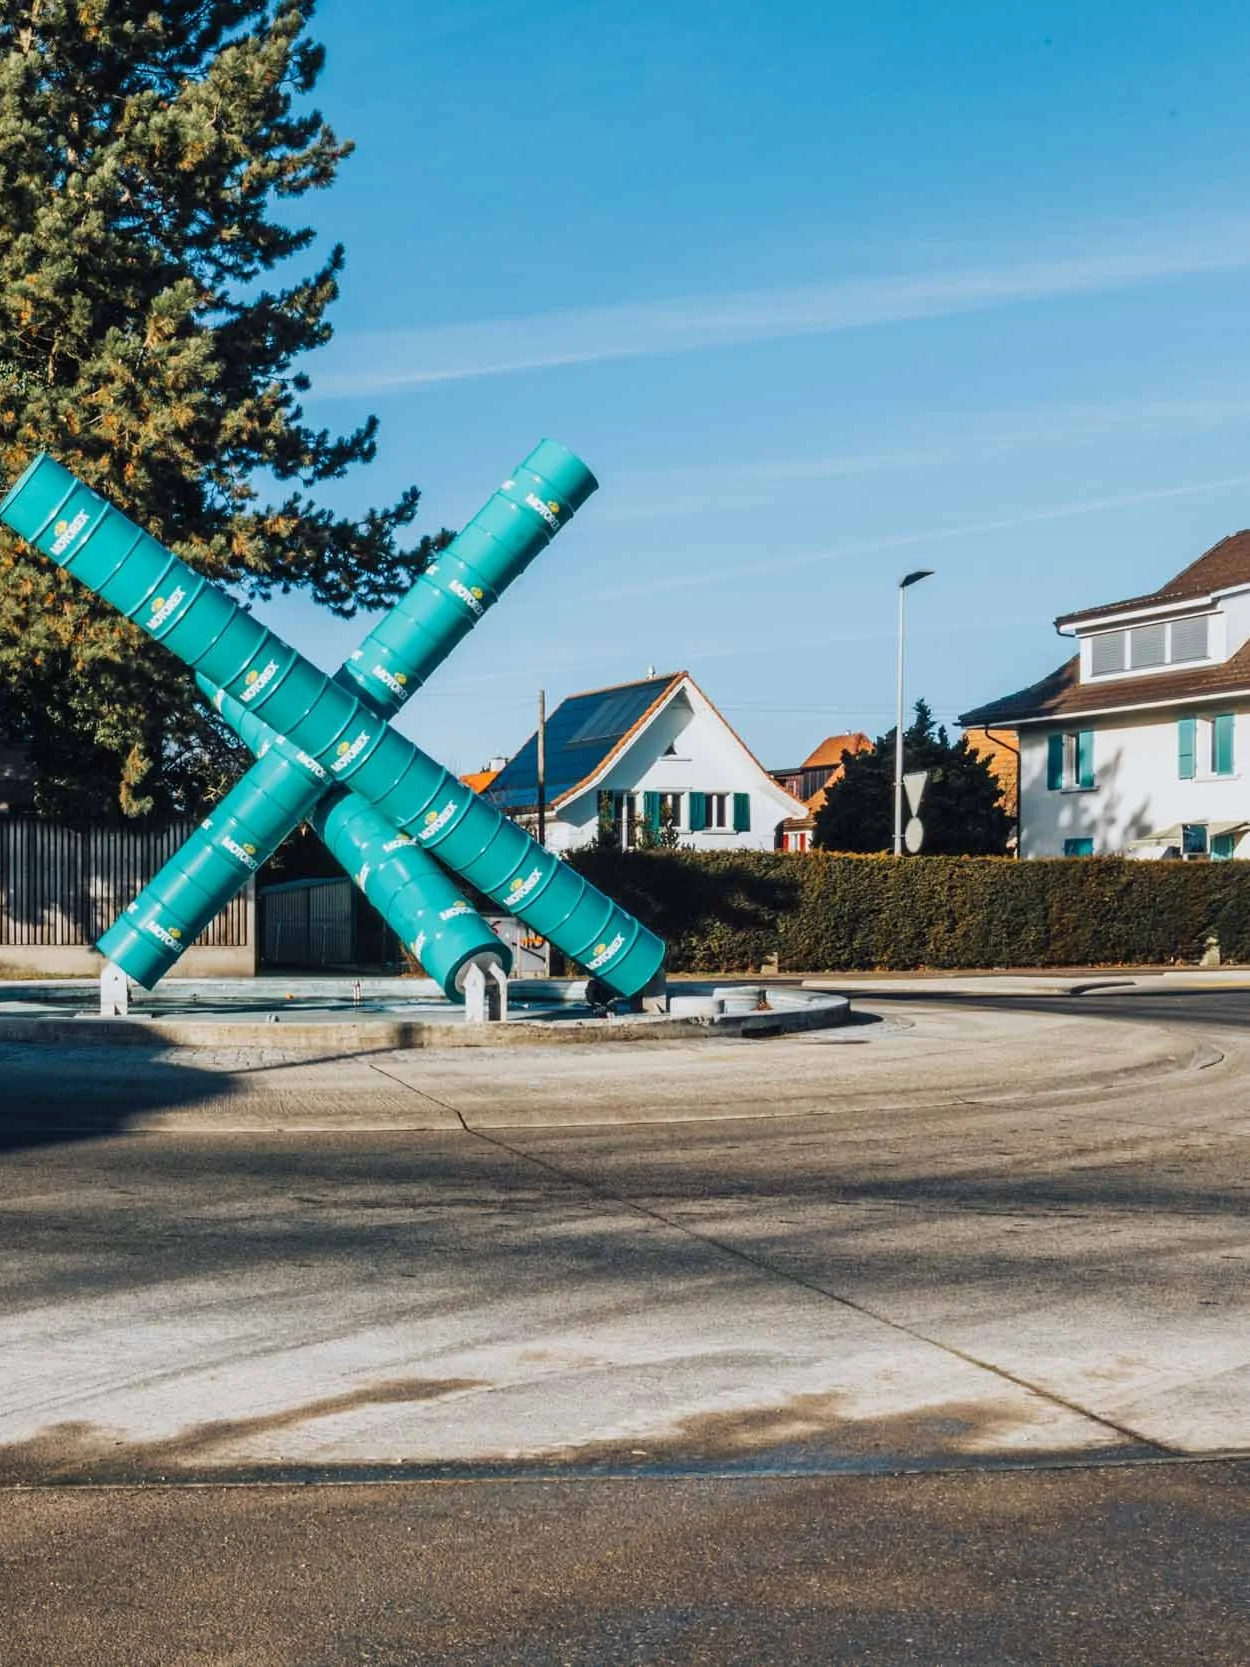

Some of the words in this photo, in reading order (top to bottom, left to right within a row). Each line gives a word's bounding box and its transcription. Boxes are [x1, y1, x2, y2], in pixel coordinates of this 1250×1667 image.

[146, 585, 186, 630] MOTOREX
[239, 659, 278, 702] MOTOREX
[330, 729, 370, 772] MOTOREX
[418, 800, 457, 840] MOTOREX
[503, 867, 542, 905] MOTOREX
[585, 931, 625, 969] MOTOREX
